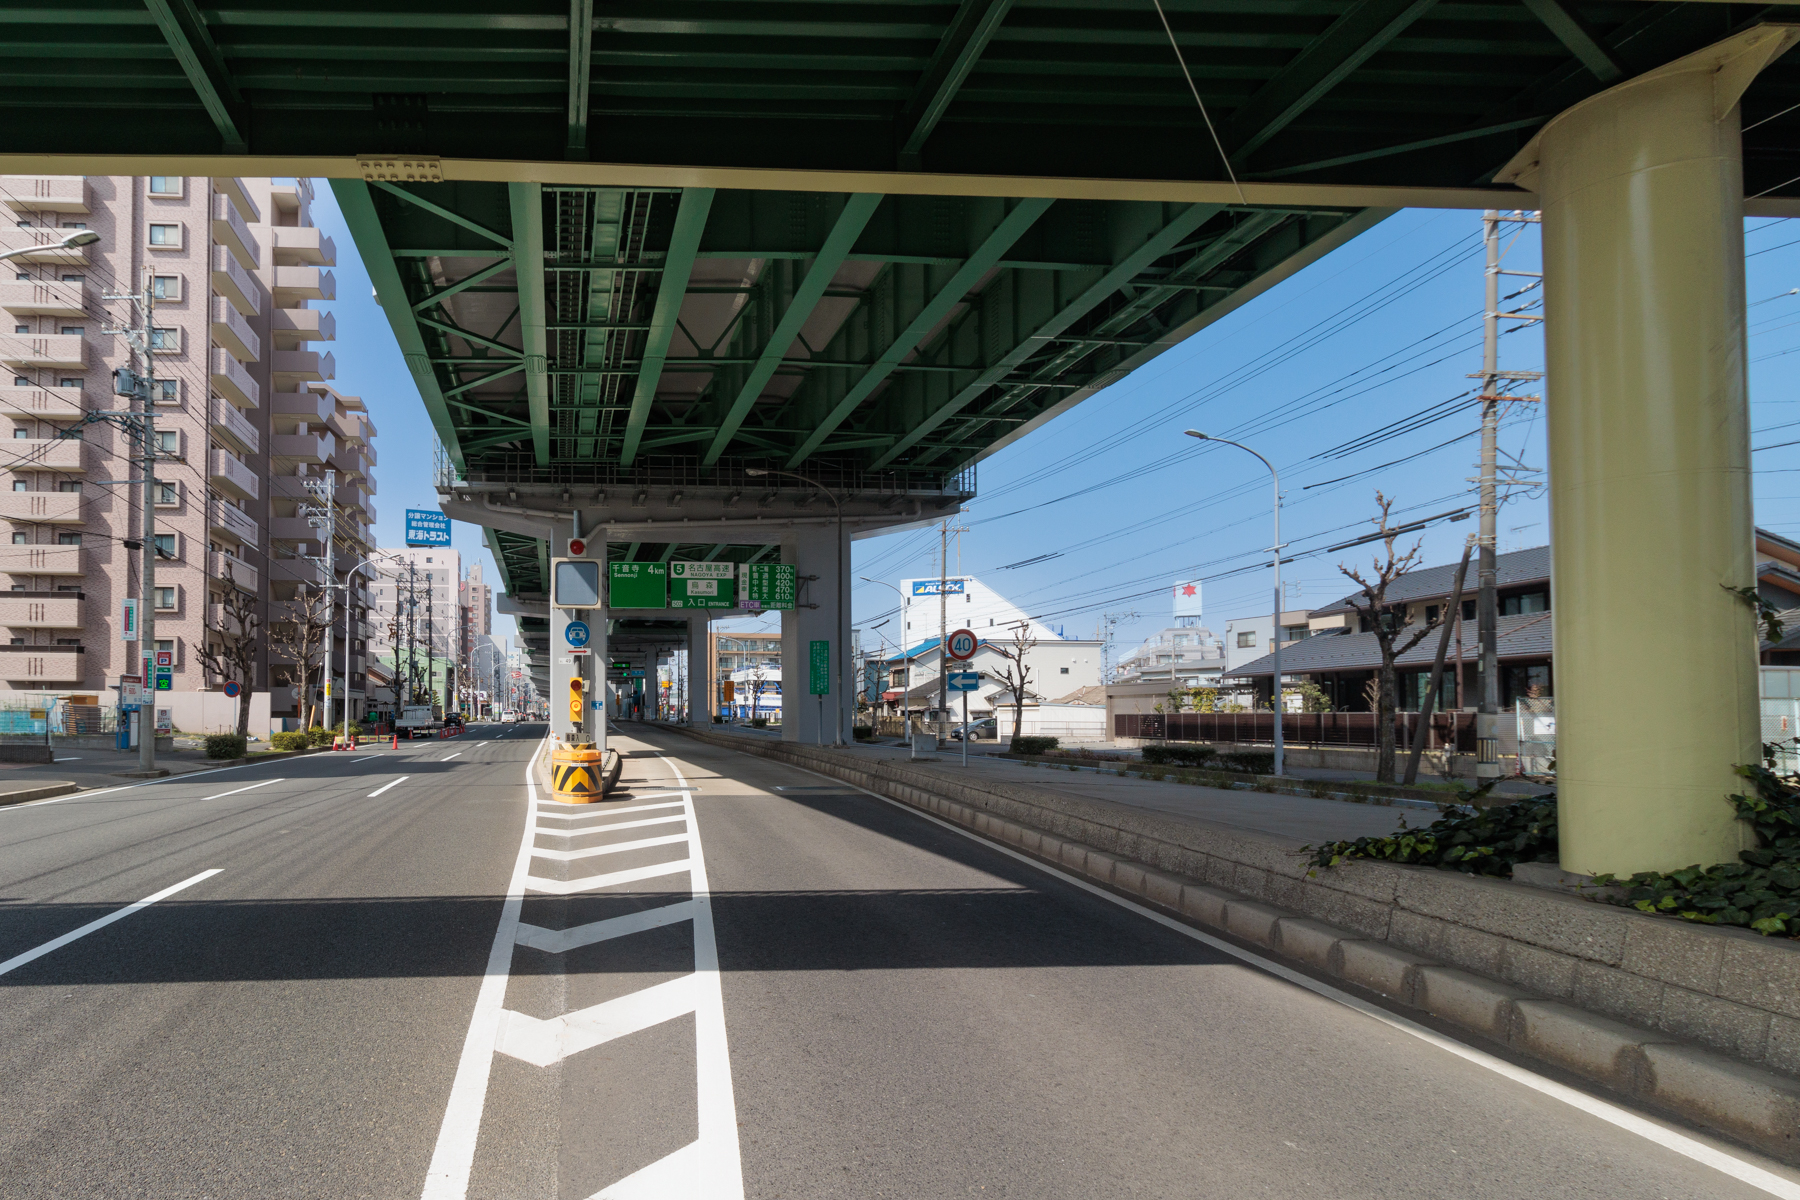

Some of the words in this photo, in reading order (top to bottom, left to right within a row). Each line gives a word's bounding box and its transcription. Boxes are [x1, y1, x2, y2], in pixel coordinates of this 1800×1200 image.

[408, 512, 448, 521] 分譲マンション
[411, 521, 446, 529] 総合管理会社
[408, 530, 449, 541] 東海トラスト
[612, 564, 639, 573] 千音寺
[648, 565, 664, 574] 4km
[676, 565, 682, 573] 5
[688, 564, 729, 572] 名古屋高速
[954, 638, 970, 651] 40
[159, 679, 169, 688] 空
